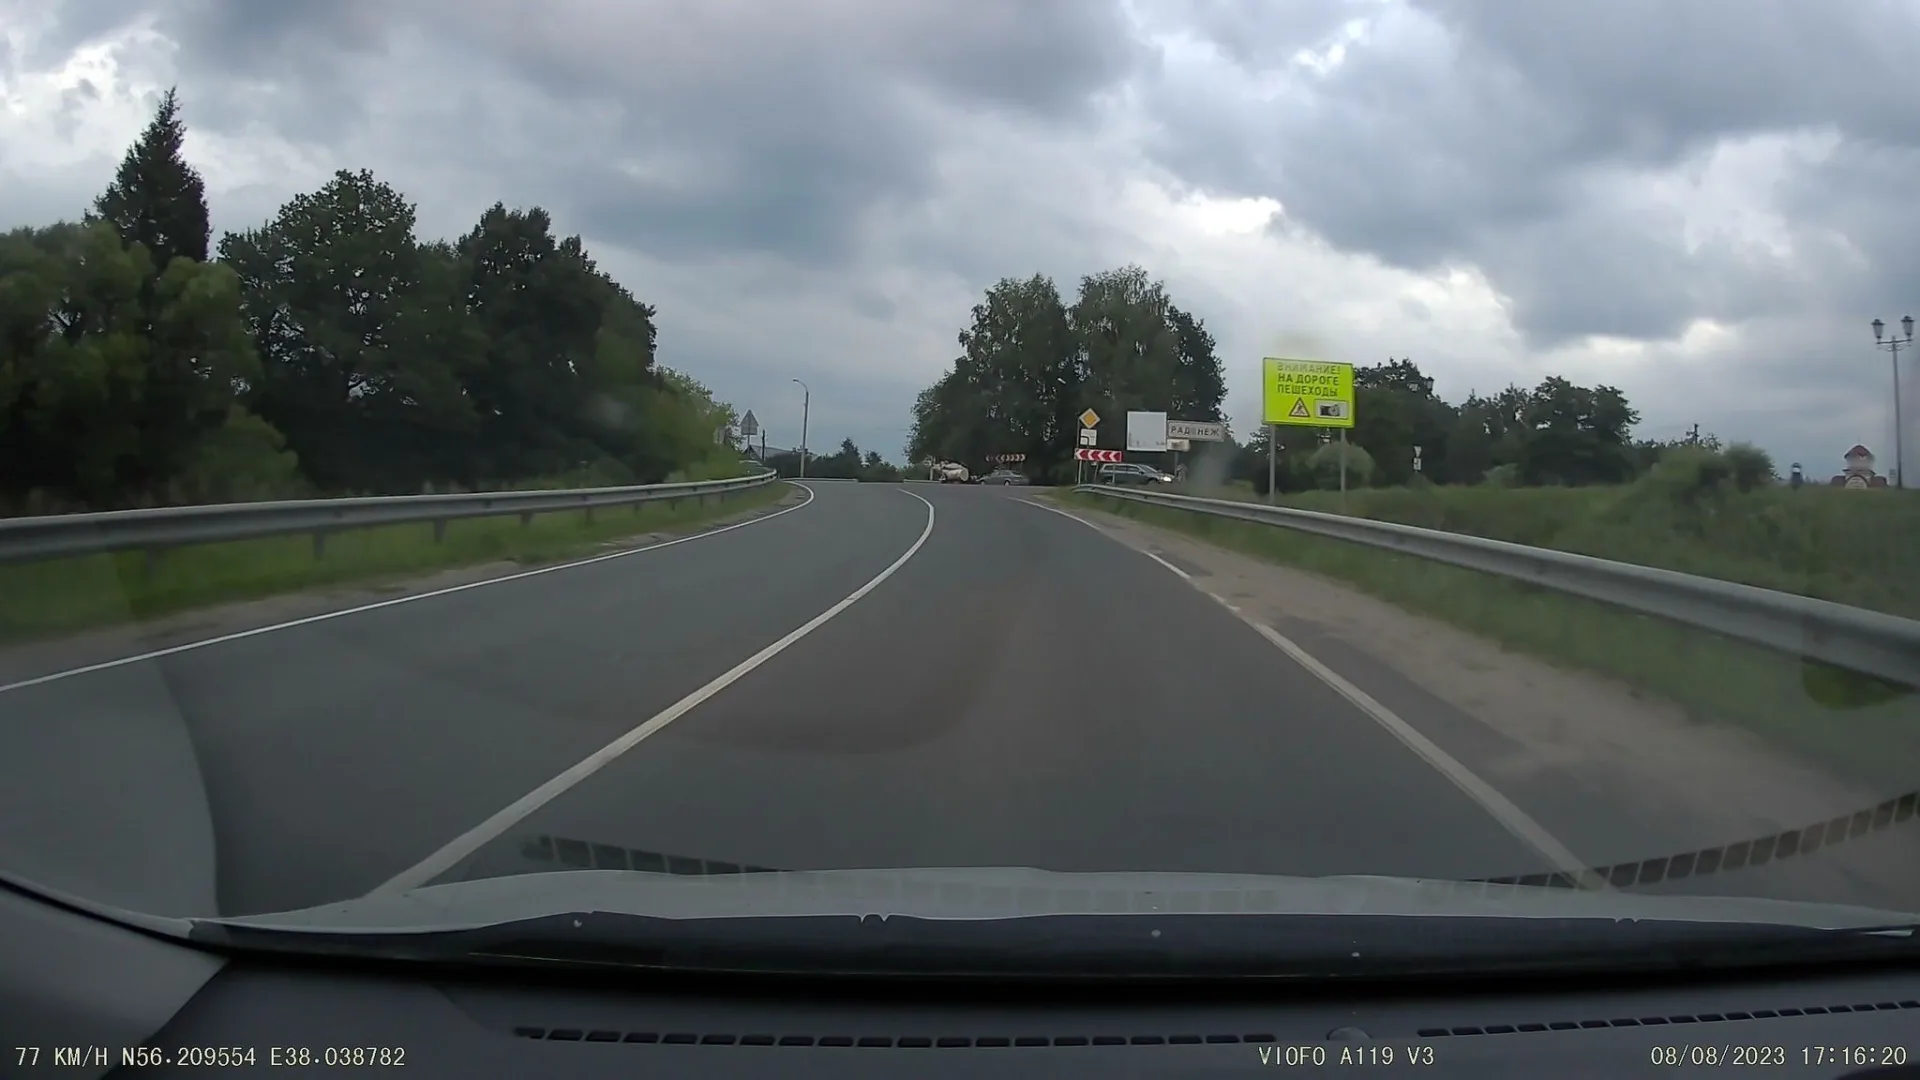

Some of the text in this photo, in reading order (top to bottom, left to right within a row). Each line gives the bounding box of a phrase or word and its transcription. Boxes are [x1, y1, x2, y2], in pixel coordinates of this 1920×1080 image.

[1277, 362, 1341, 375] ВНИМАНИЕ!
[1277, 372, 1340, 386] НА ДОРОГЕ
[1277, 384, 1338, 397] ПЕШЕХОДЫ
[1170, 425, 1220, 436] РАДНЕЖ
